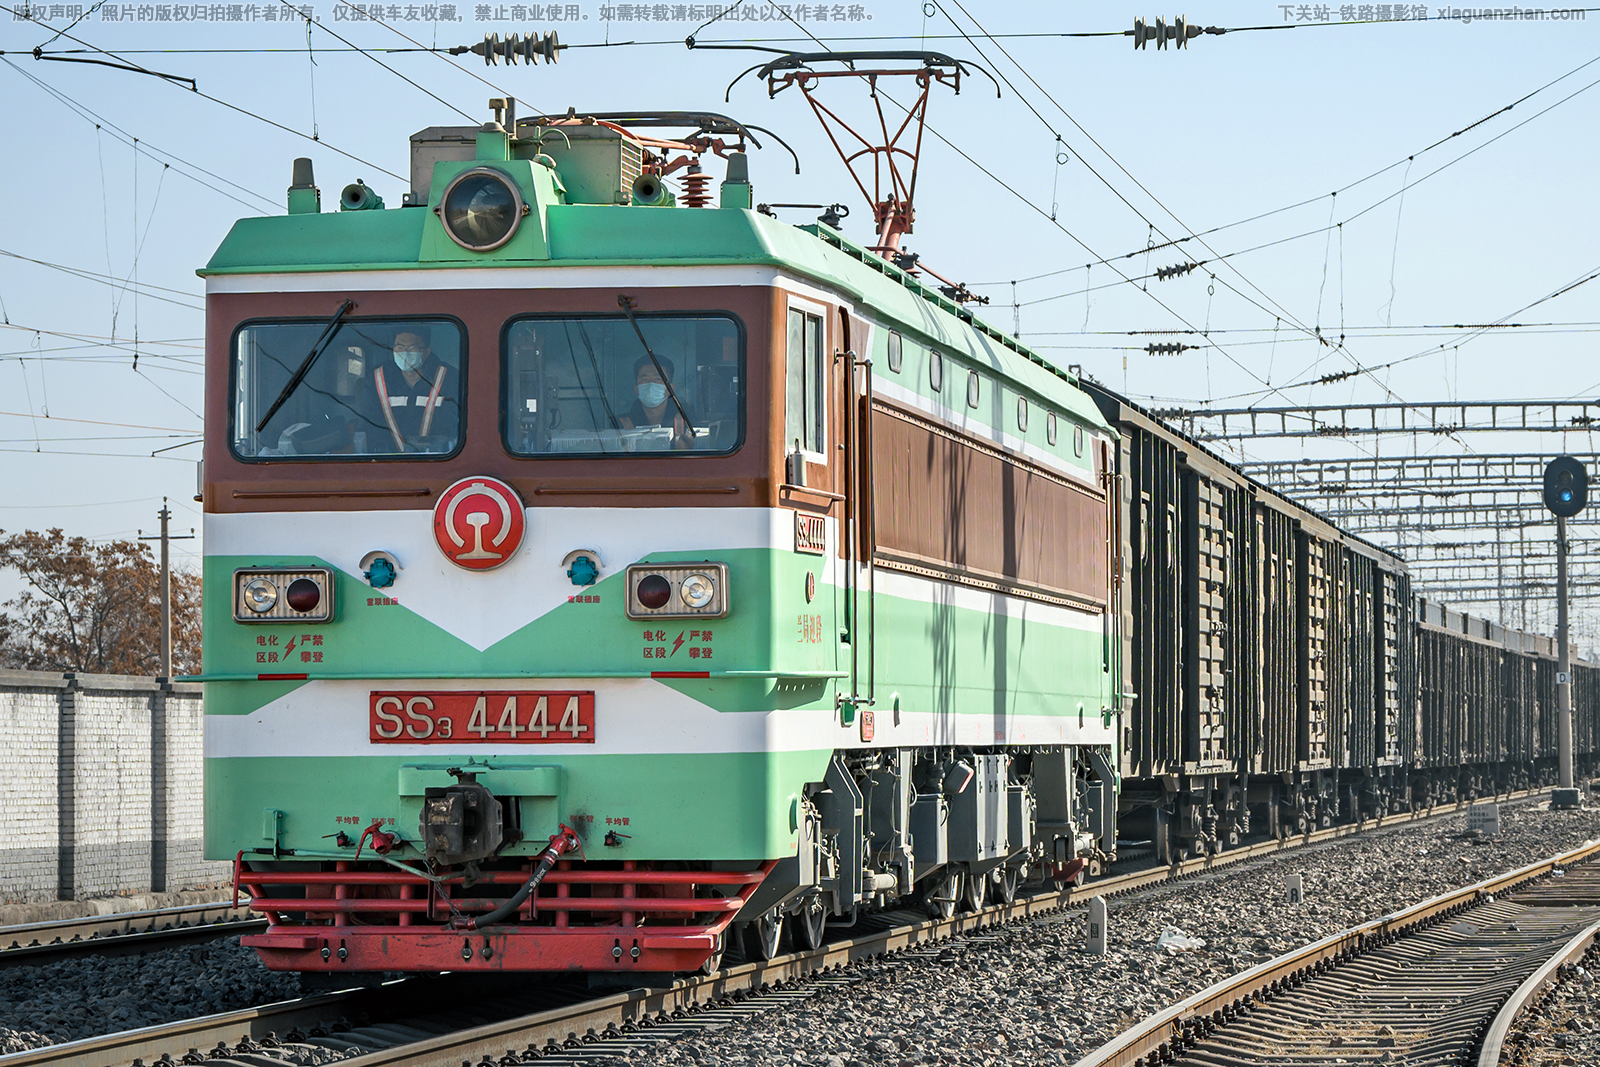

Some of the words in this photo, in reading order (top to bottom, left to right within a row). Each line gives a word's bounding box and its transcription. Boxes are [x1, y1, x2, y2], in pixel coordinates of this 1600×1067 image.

[256, 635, 279, 646] 电化
[300, 634, 324, 646] 严禁
[643, 630, 667, 642] 电化
[689, 630, 713, 642] 严禁
[256, 652, 279, 663] 区段
[300, 651, 324, 663] 攀登
[643, 647, 667, 659] 区段
[689, 647, 713, 659] 攀登
[375, 696, 453, 739] SS3
[467, 696, 588, 739] 4444
[335, 816, 360, 825] 平均管
[605, 817, 630, 826] 平均管
